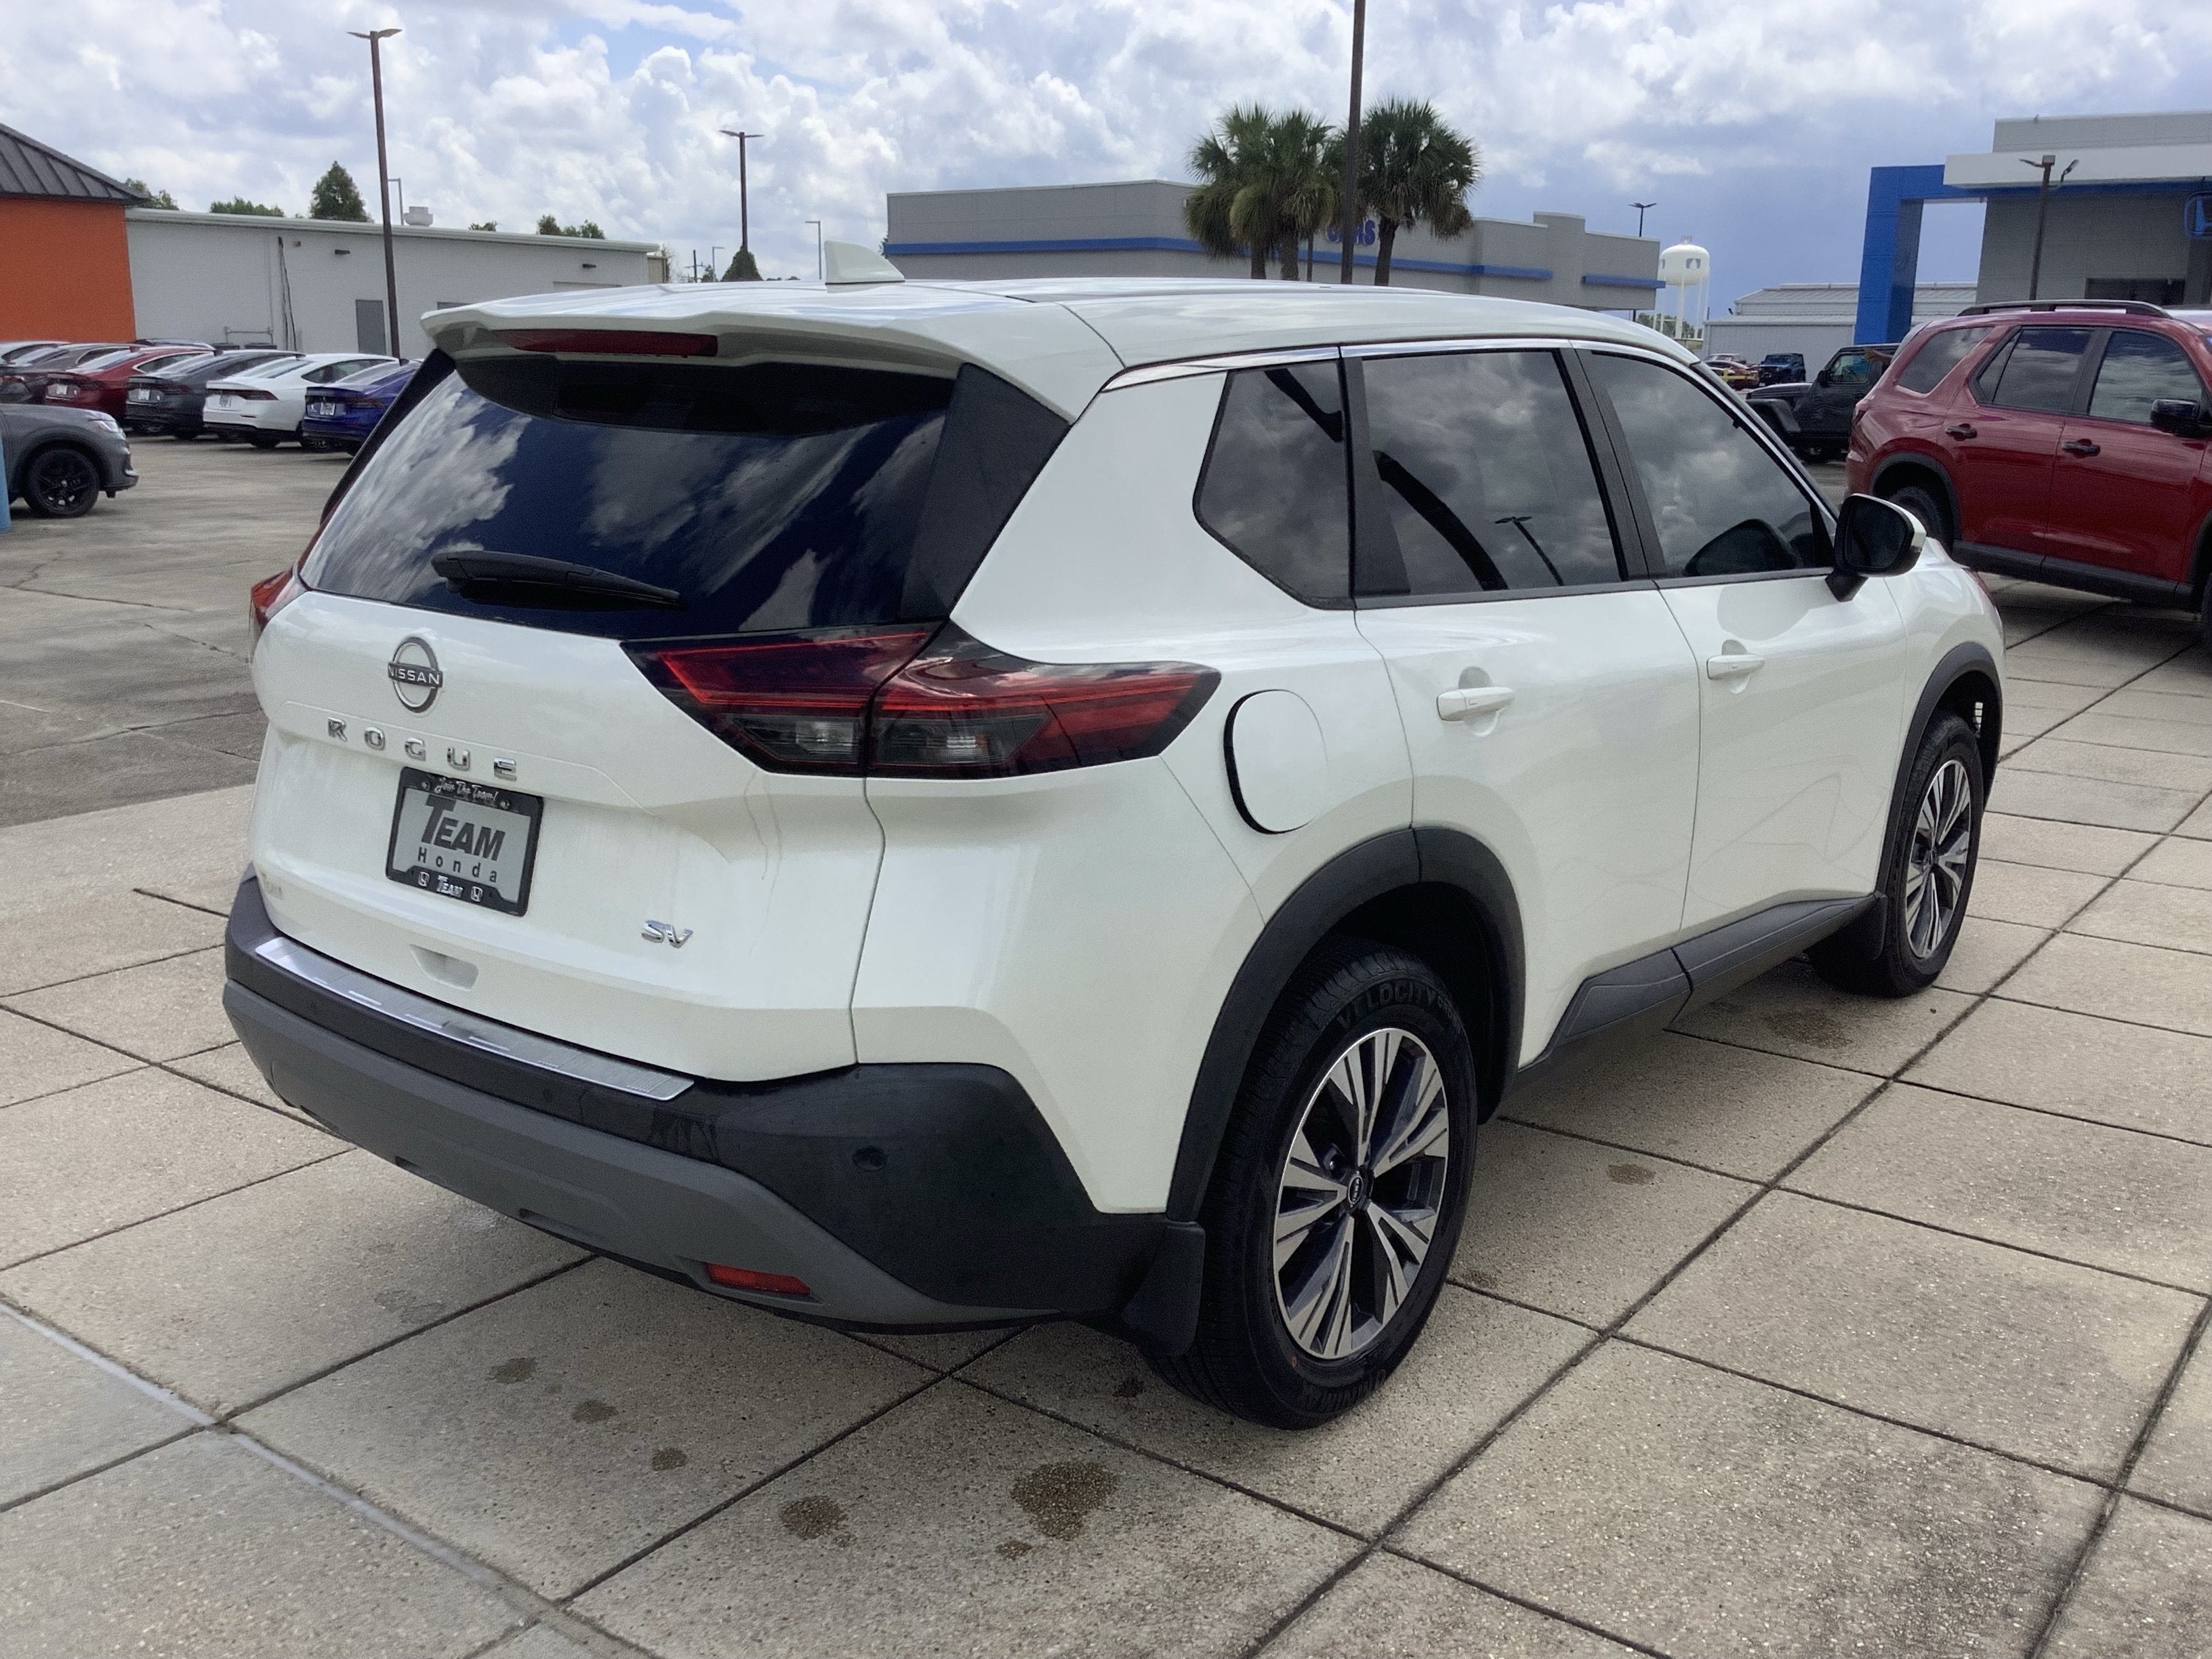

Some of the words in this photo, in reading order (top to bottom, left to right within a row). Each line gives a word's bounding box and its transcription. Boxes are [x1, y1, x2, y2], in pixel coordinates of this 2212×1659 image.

[389, 665, 440, 685] NISSAN
[328, 716, 517, 782] ROGUE
[418, 846, 497, 883] Honda
[641, 920, 694, 948] SV
